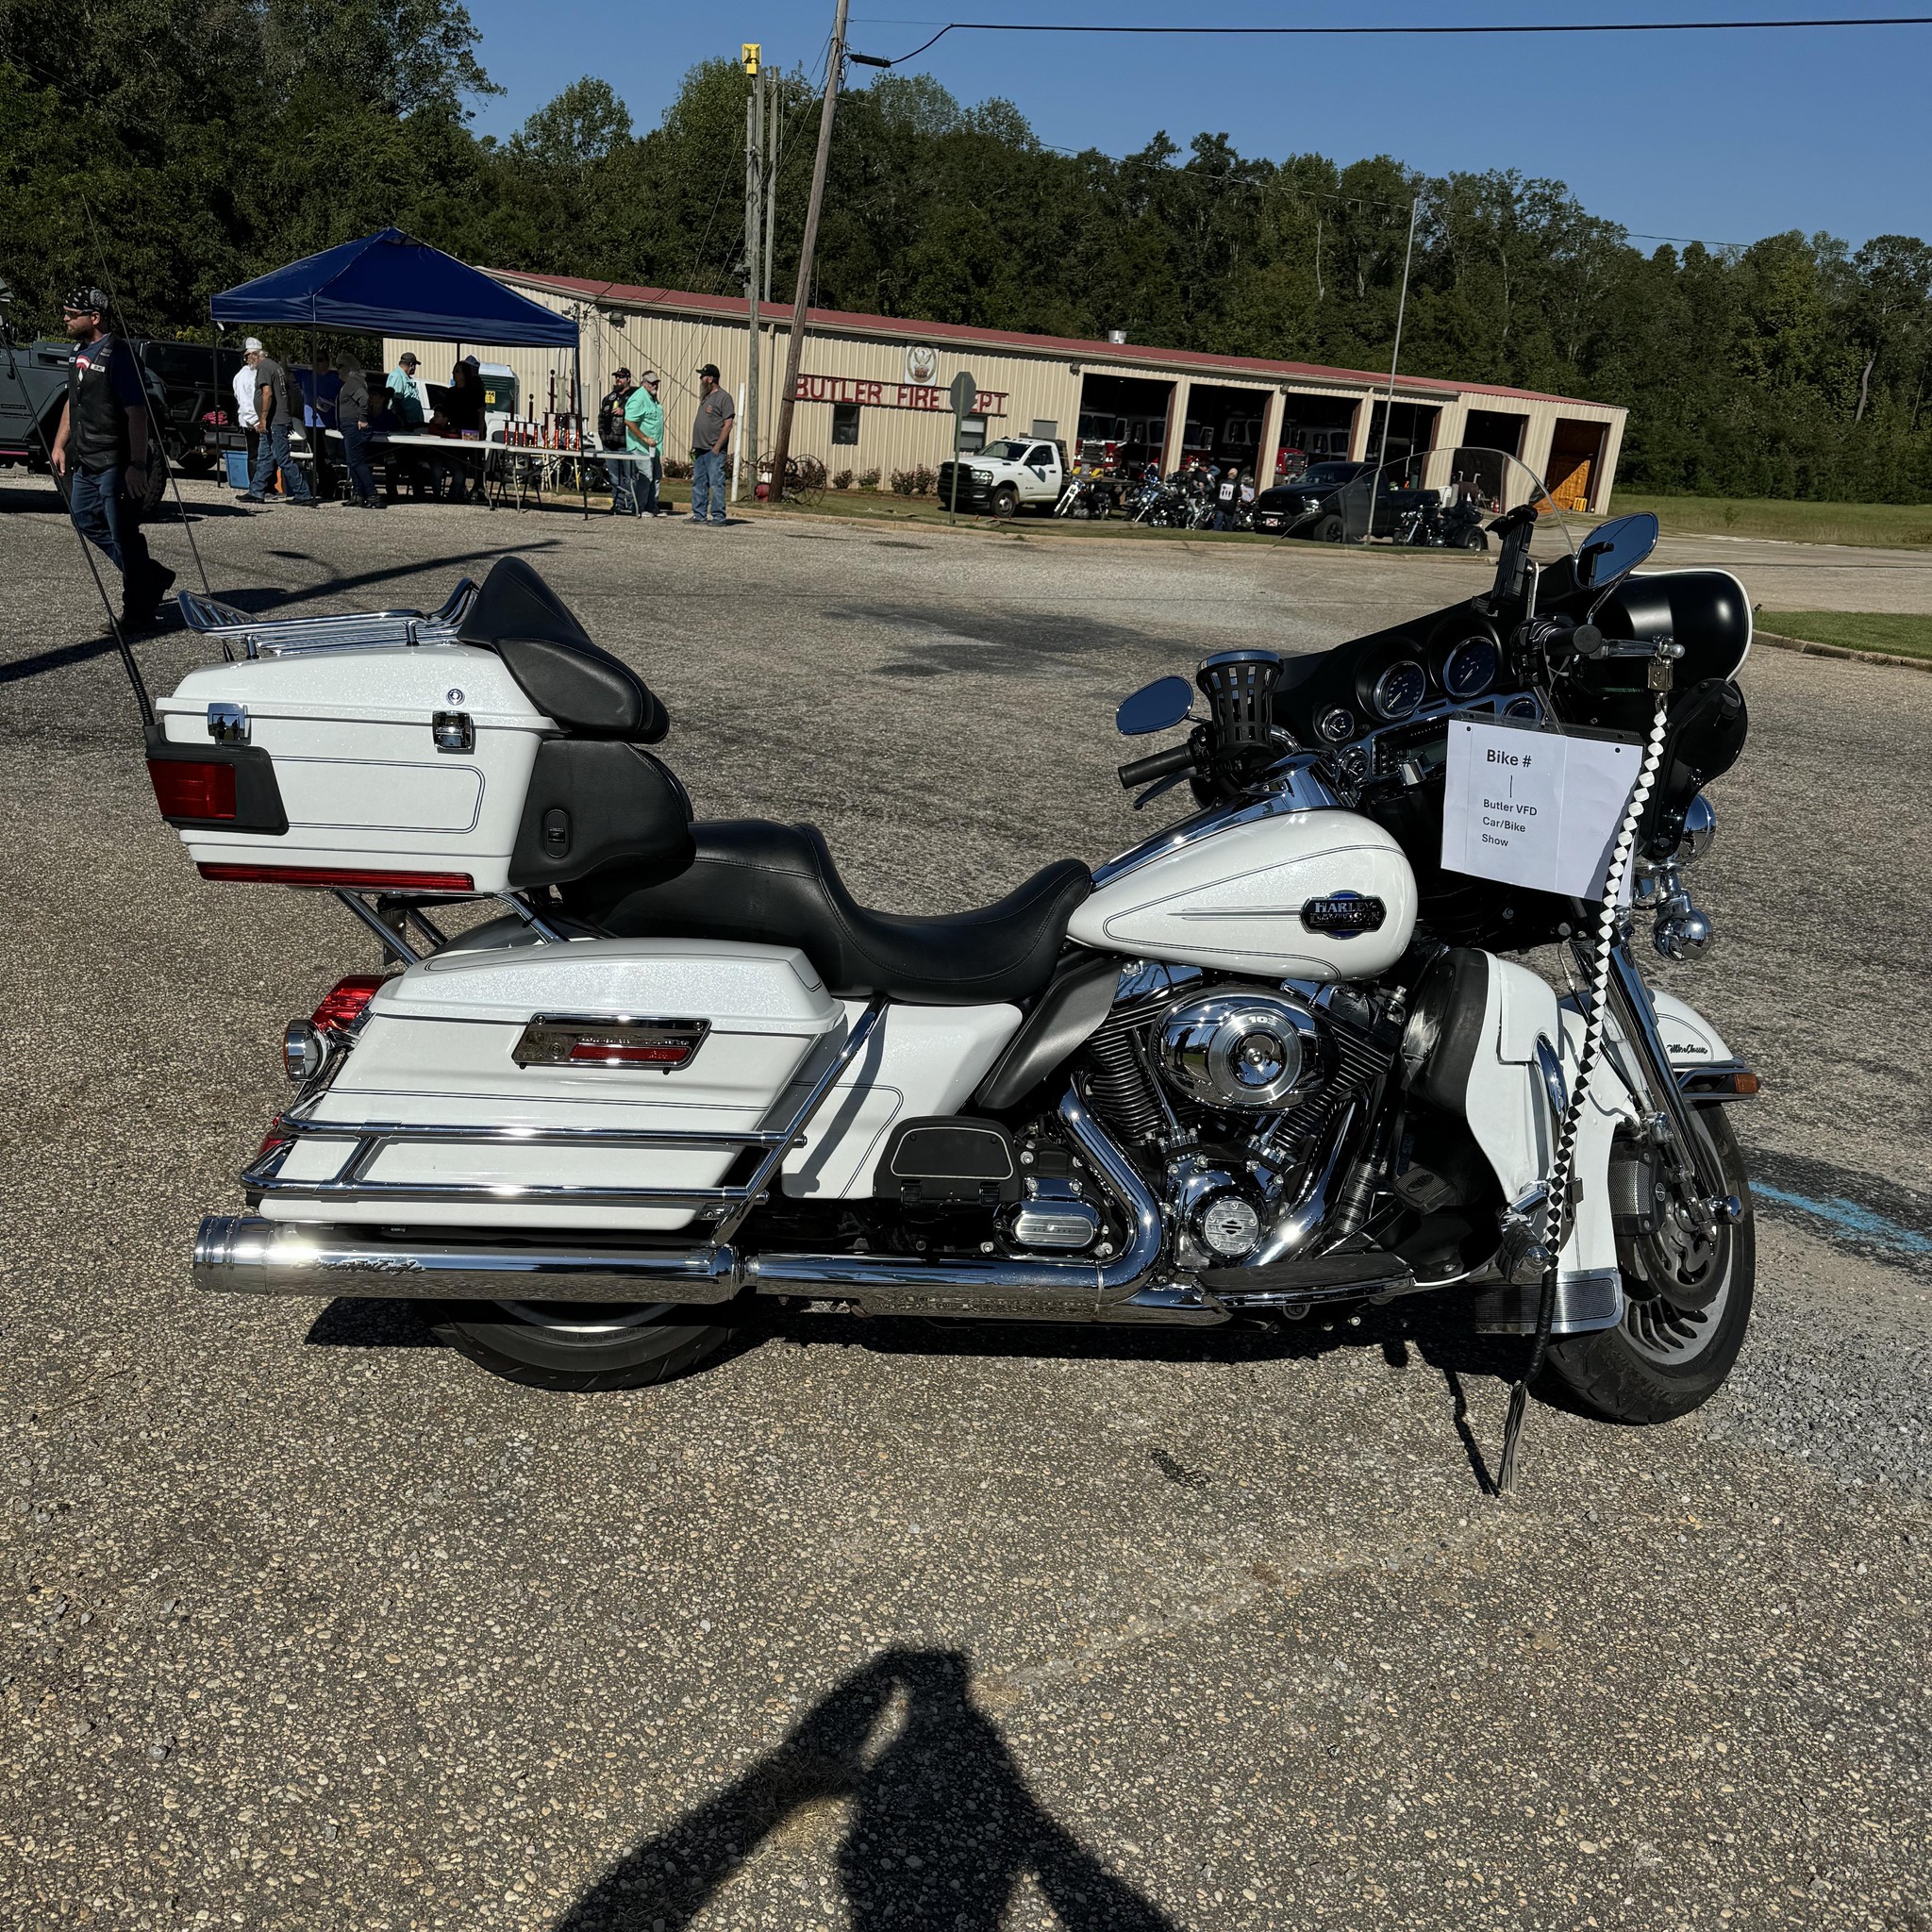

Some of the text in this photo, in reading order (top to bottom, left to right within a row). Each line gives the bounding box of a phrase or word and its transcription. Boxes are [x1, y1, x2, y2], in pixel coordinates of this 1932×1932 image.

[794, 377, 883, 404] BUTLER
[897, 385, 941, 408] FIRE
[1487, 749, 1532, 768] Bike #
[1483, 798, 1538, 816] Butler VFD
[1482, 816, 1526, 832] Car/Bike
[1481, 833, 1509, 846] Show
[1248, 1015, 1278, 1027] 103
